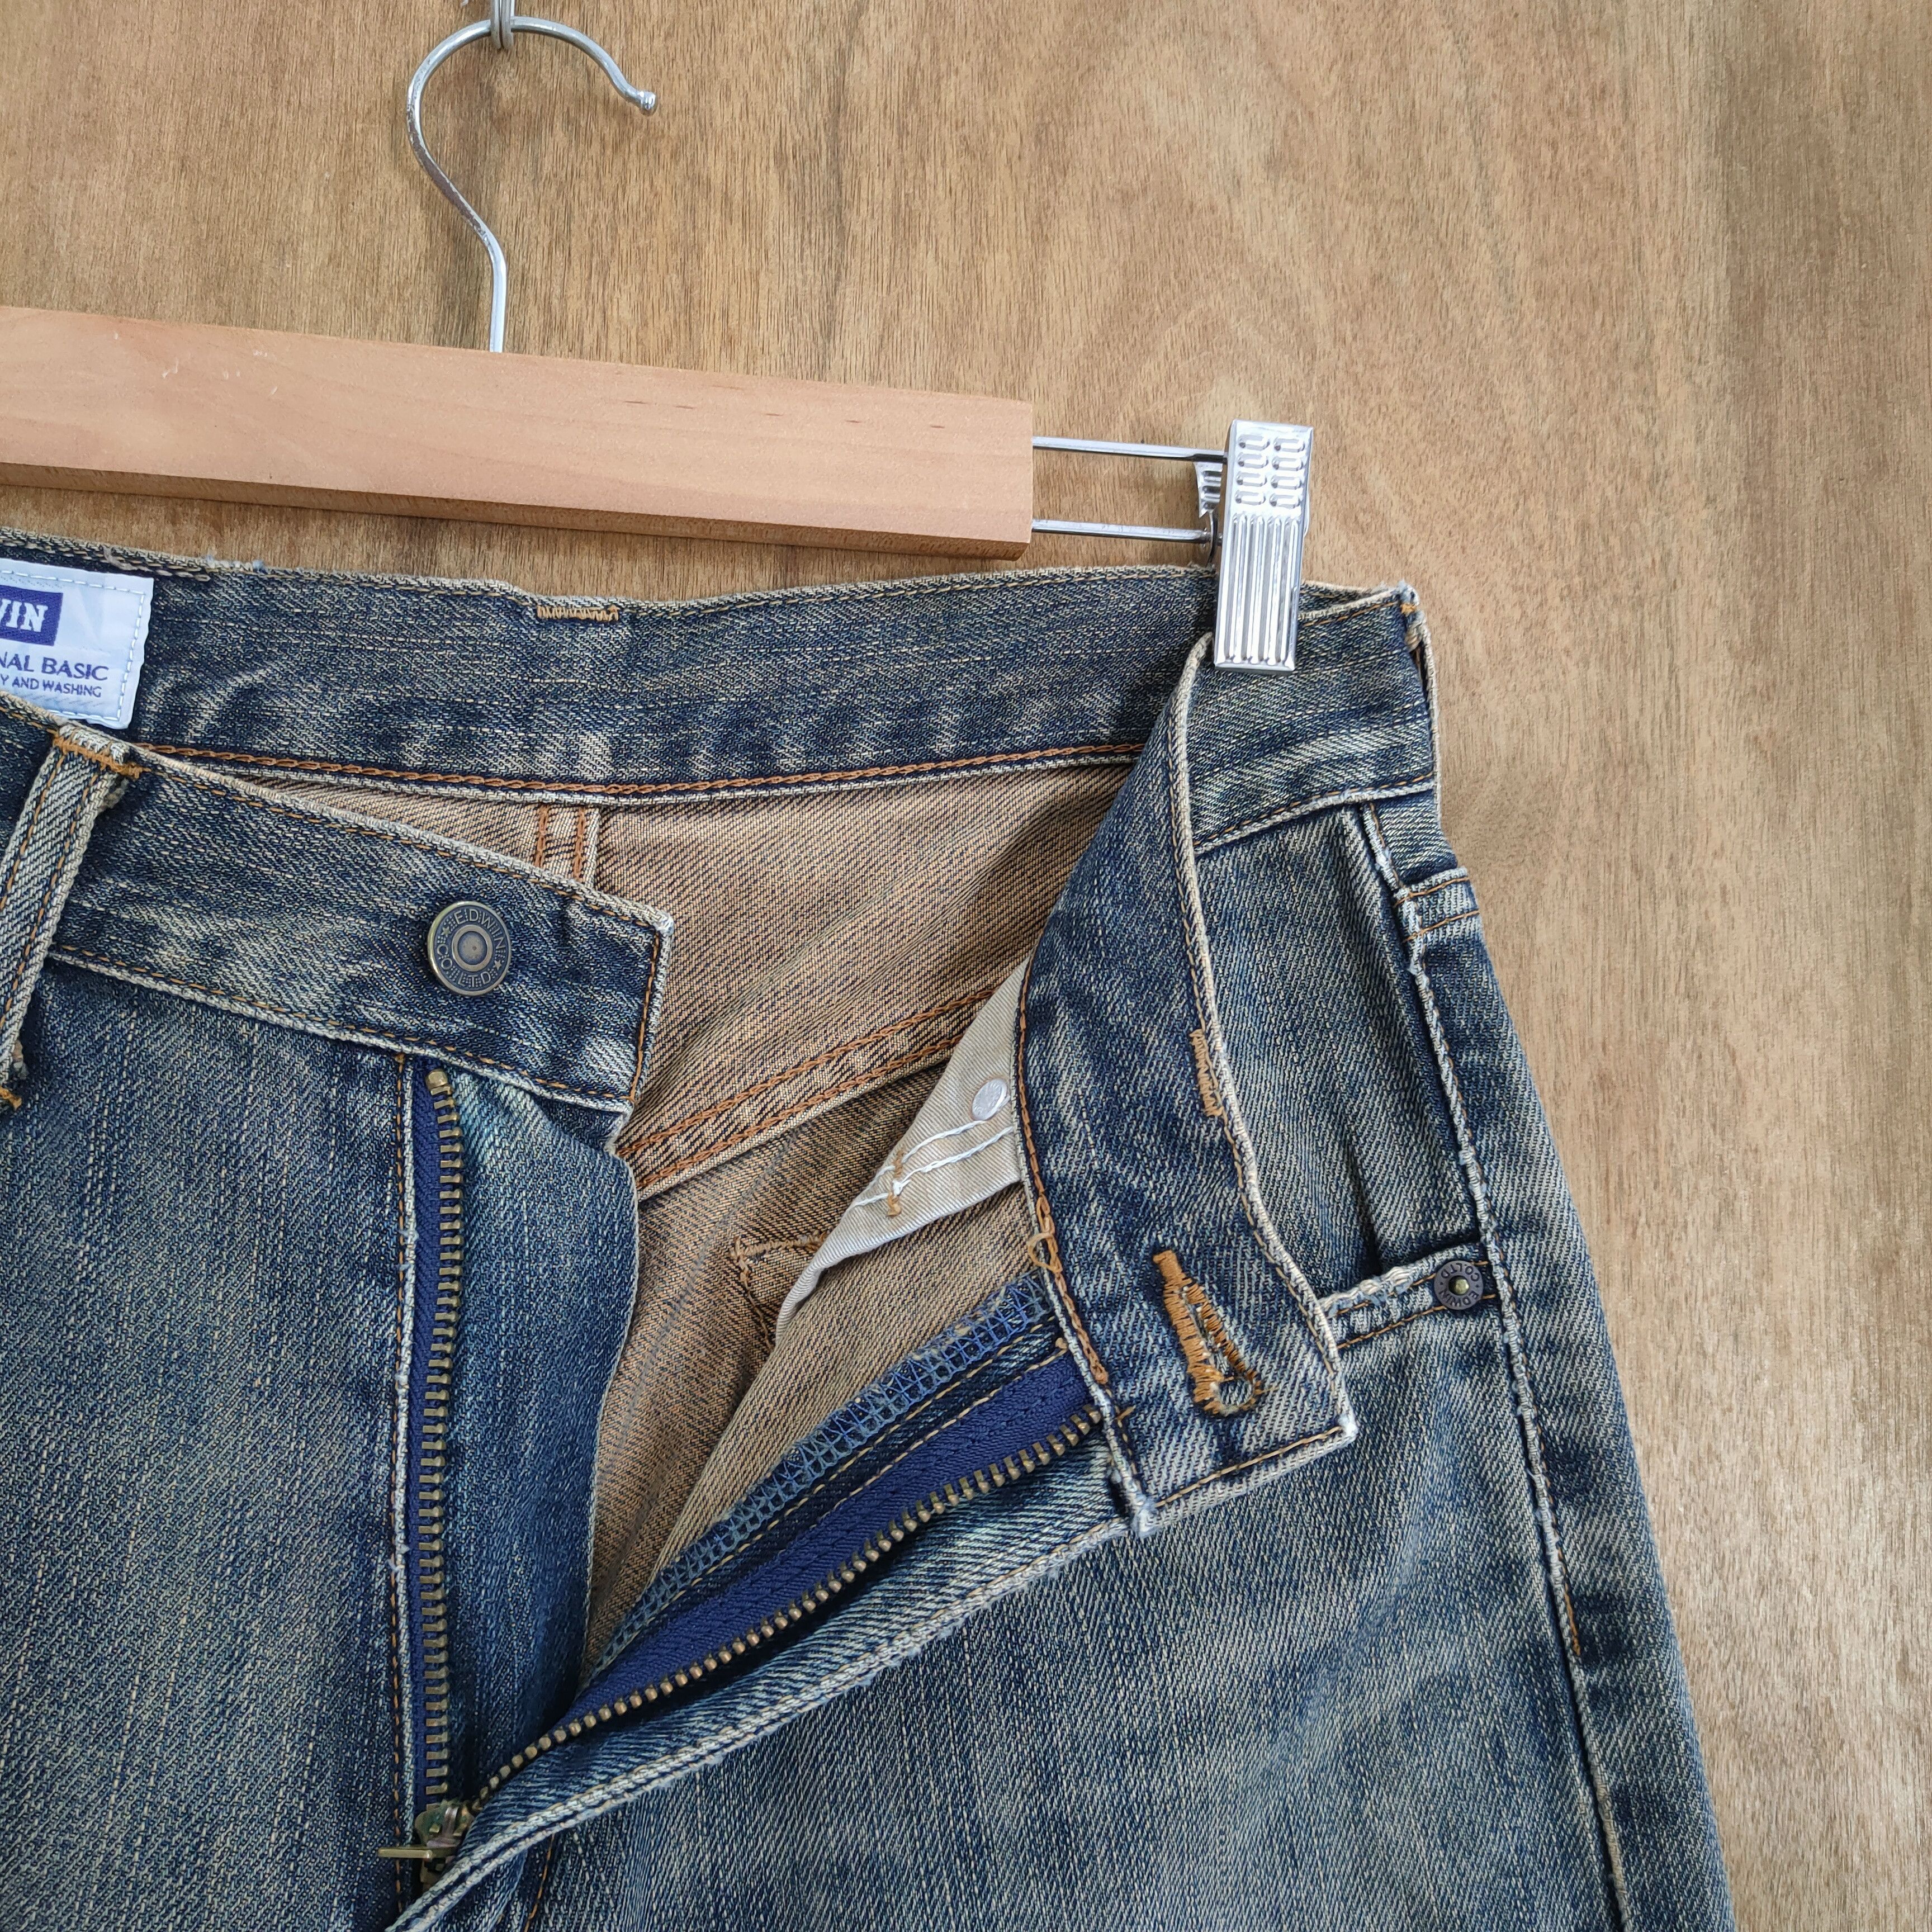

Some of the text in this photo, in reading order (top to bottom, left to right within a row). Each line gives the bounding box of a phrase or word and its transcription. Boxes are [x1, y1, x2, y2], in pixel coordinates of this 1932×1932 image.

[41, 657, 109, 681] BASIC
[12, 676, 39, 690] AND
[43, 679, 102, 698] WASHING
[454, 909, 506, 949] EDWIN
[457, 971, 491, 988] LTD
[1438, 1290, 1479, 1308] EDWIN
